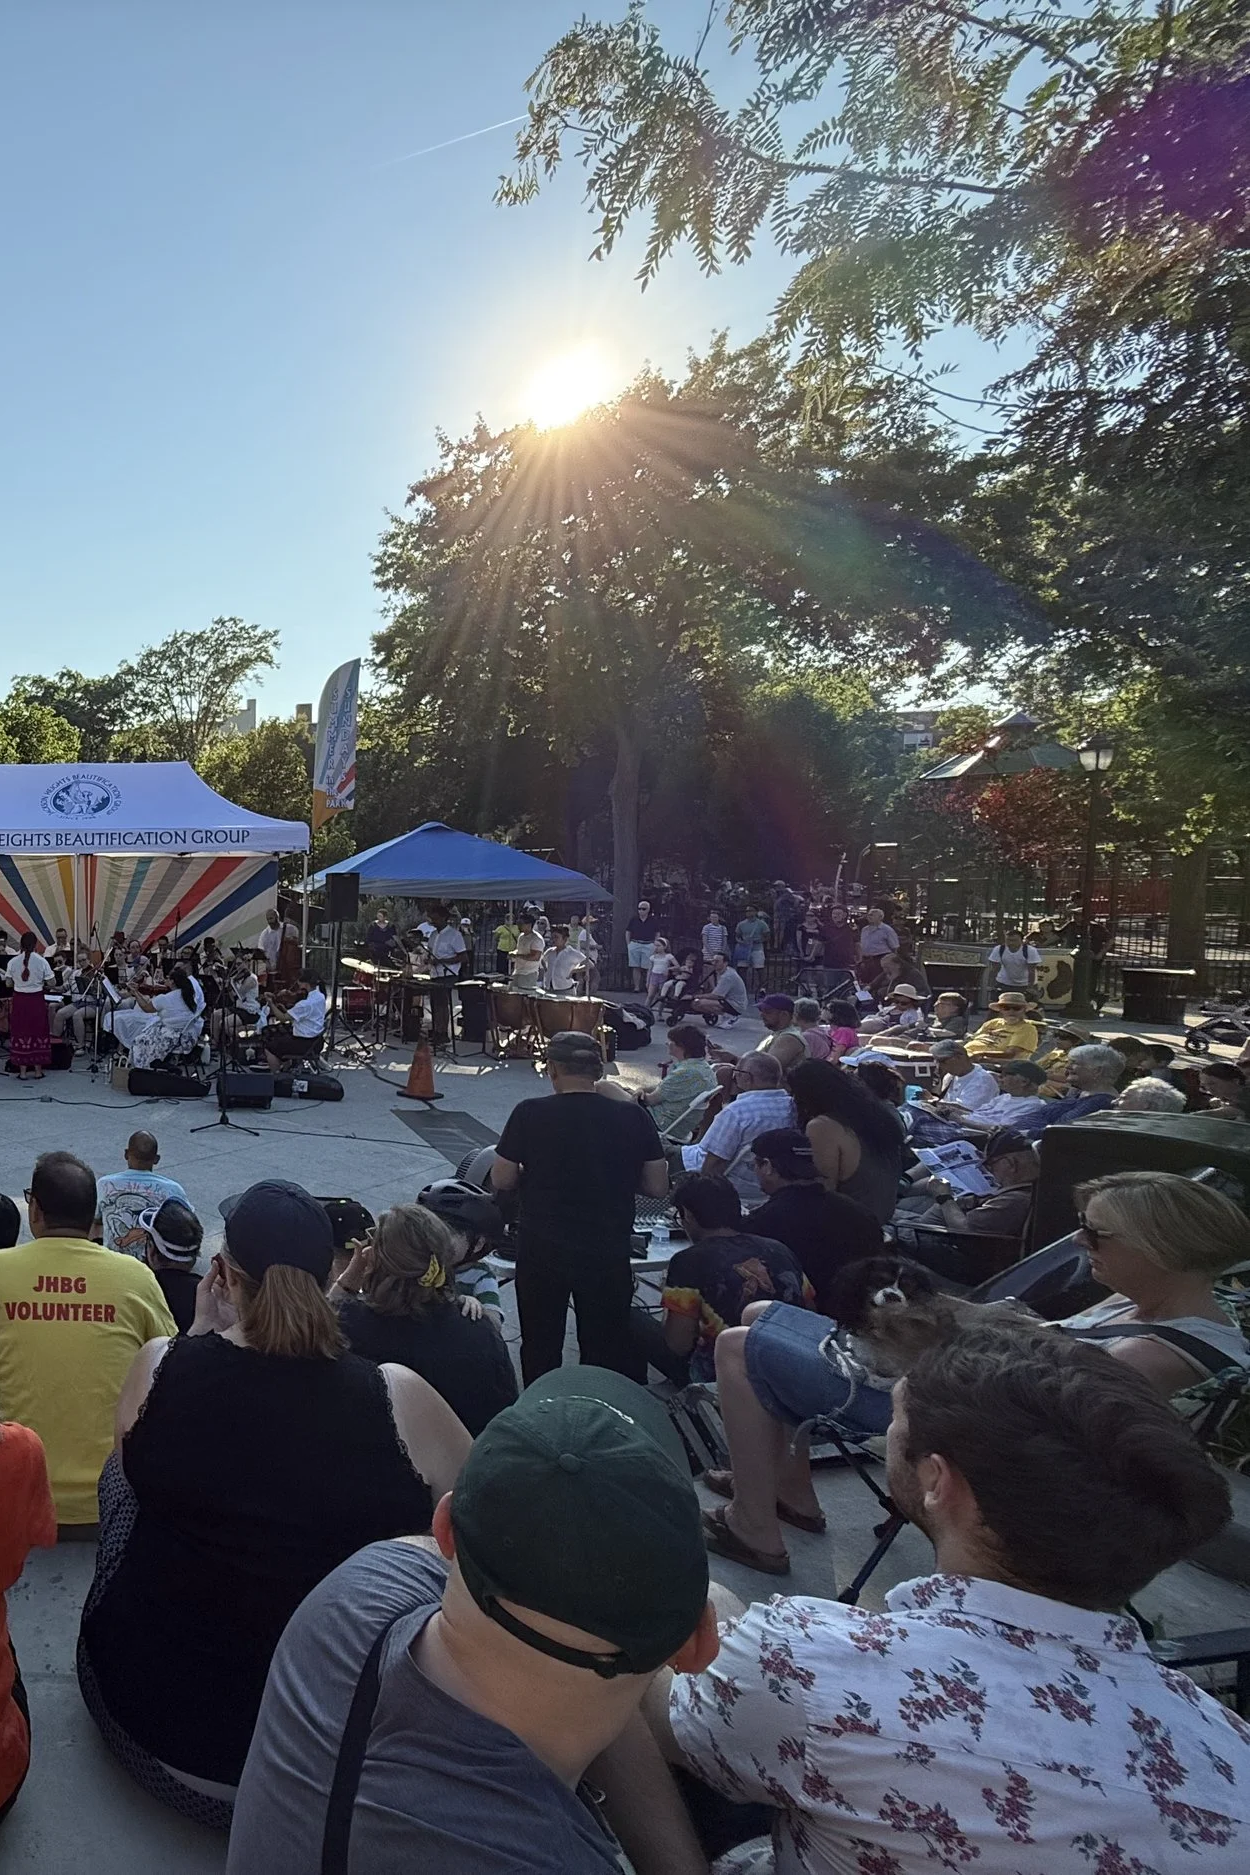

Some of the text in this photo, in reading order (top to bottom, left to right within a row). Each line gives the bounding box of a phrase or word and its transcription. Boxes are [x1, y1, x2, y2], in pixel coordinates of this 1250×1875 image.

[327, 688, 339, 770] SUMMER
[340, 688, 352, 782] SUNDAYS
[45, 776, 71, 796] HEIGHTS
[72, 774, 122, 799] BEAUTIFICATION
[326, 775, 335, 785] in
[326, 799, 348, 809] PARK
[55, 831, 187, 846] BEAUTIFICATION
[191, 829, 250, 844] GROUP
[33, 1275, 87, 1294] JHBG
[4, 1302, 116, 1323] VOLUNTEER
